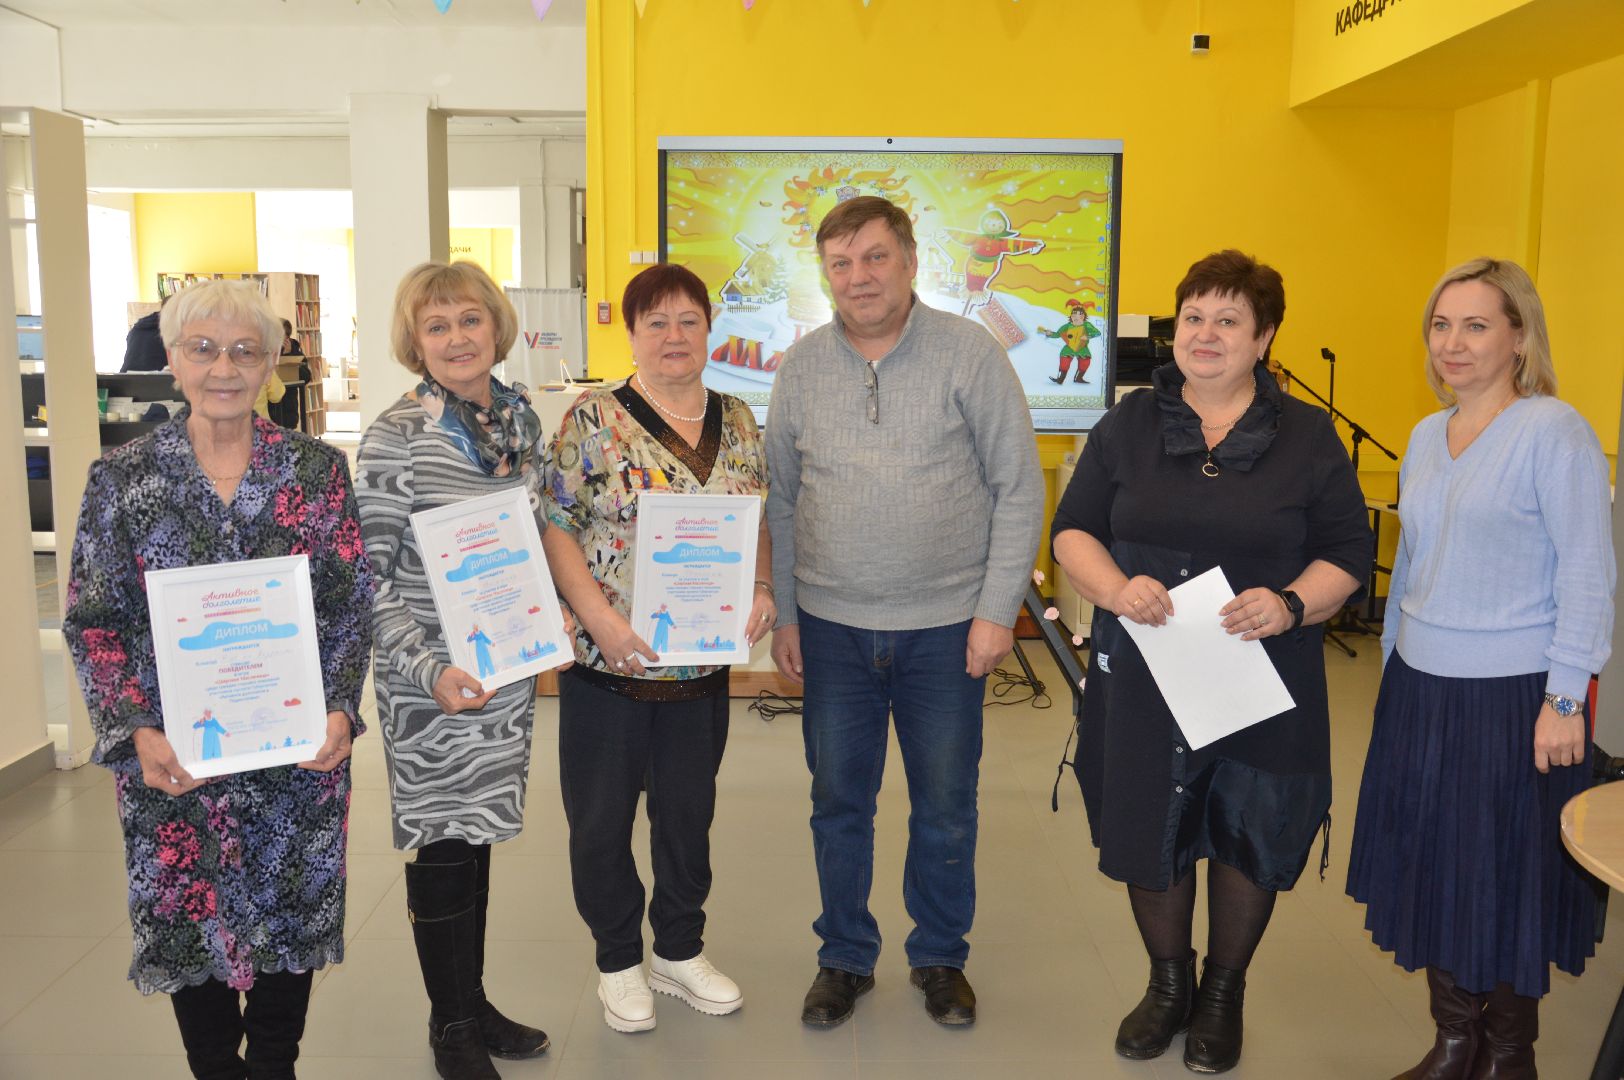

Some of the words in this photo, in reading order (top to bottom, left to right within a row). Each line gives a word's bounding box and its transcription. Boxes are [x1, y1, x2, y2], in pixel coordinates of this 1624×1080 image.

[470, 552, 508, 571] ДИПЛОМ
[679, 548, 720, 559] ДИПЛОМ
[215, 623, 268, 641] ДИПЛОМ
